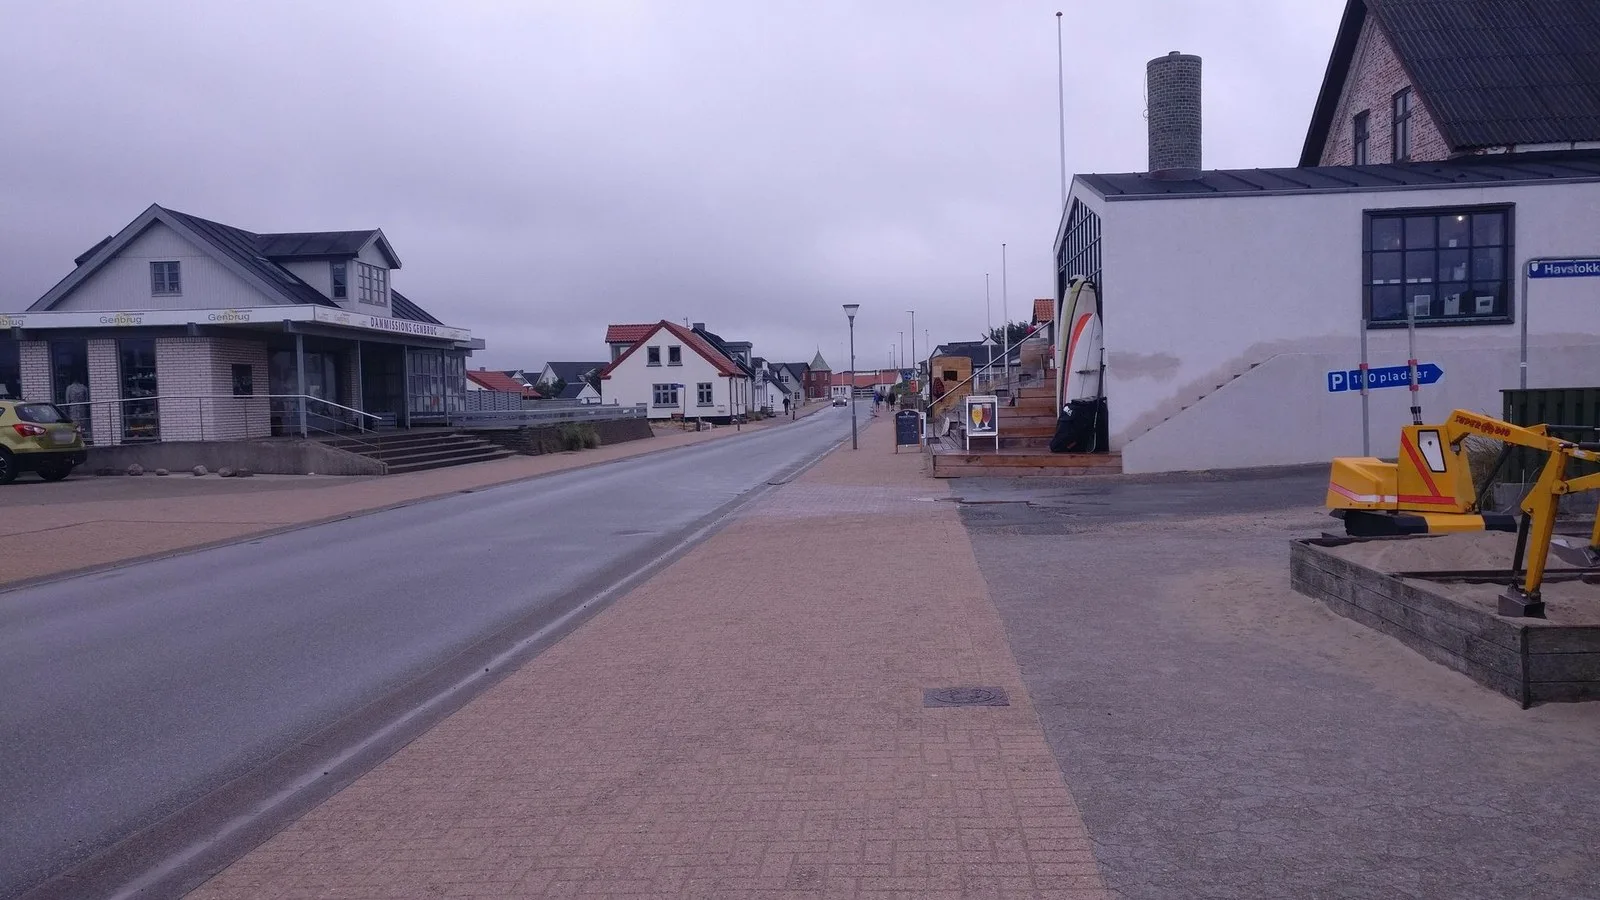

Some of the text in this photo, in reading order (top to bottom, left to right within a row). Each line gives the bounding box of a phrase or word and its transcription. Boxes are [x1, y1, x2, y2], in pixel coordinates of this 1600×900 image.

[99, 316, 142, 324] Genbrug
[208, 313, 250, 321] Genbrug
[0, 318, 24, 327] brug
[370, 317, 437, 336] DANMISSIONS GENBRUG
[1332, 374, 1343, 390] P
[1353, 373, 1376, 384] 10
